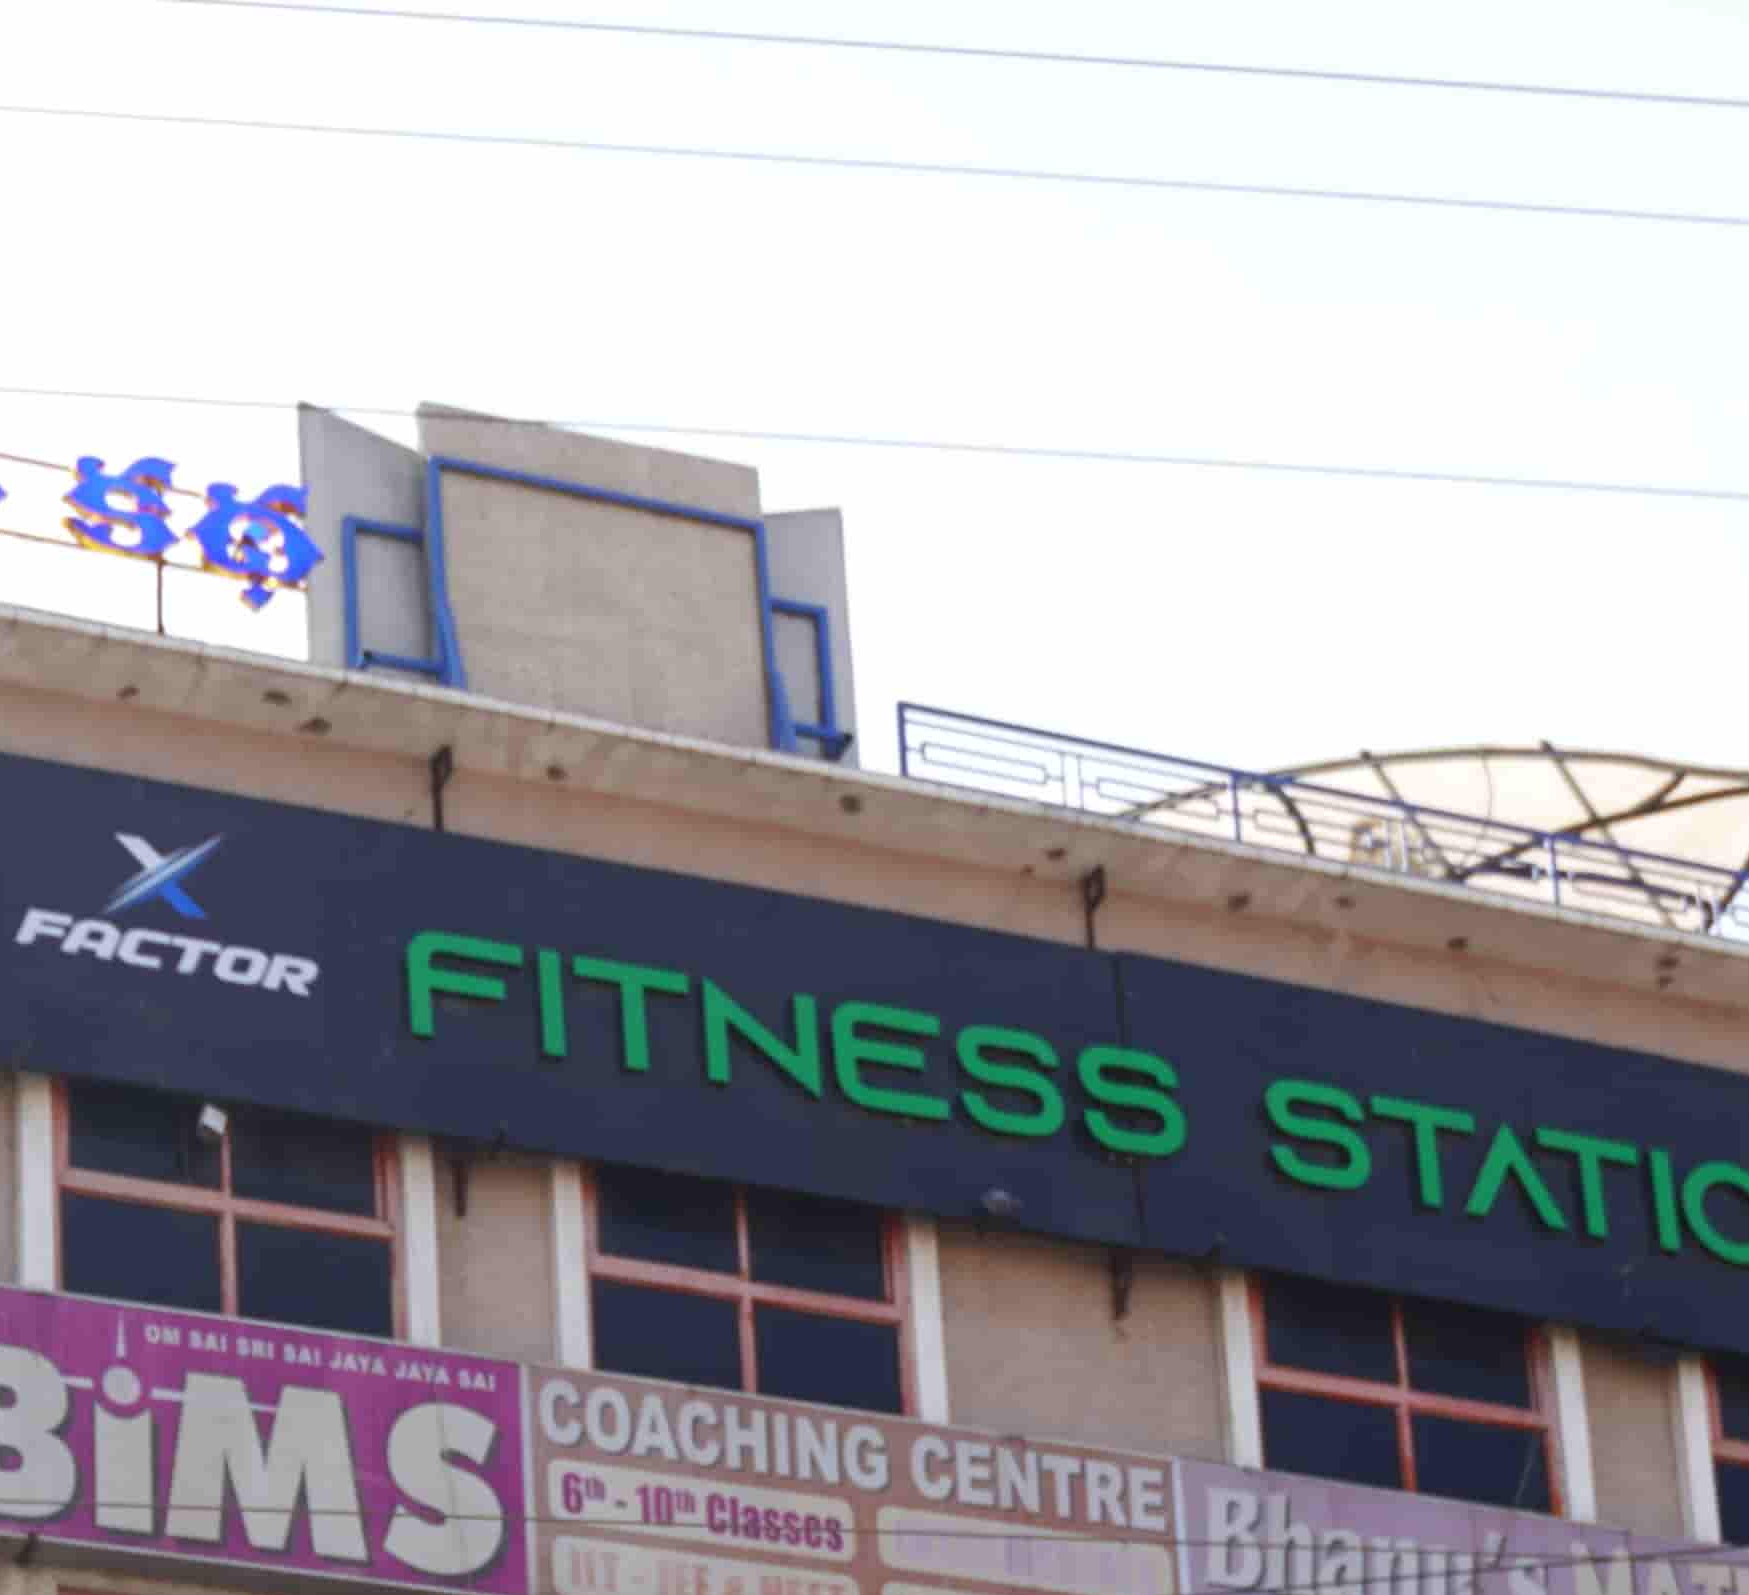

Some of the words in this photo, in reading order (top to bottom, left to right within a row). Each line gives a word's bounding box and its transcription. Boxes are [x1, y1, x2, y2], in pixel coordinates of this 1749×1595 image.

[61, 455, 324, 611] కథ
[15, 907, 319, 997] FACTOR
[405, 929, 1188, 1156] FITNESS
[144, 1322, 182, 1347] OM
[188, 1328, 228, 1356] SAI
[236, 1333, 275, 1362] SRI
[282, 1338, 323, 1367] SAI
[329, 1343, 387, 1378] JAYA
[394, 1352, 451, 1386] JAYA
[458, 1362, 497, 1394] SAI
[538, 1378, 890, 1492] COACHING
[910, 1433, 1166, 1533] CENTRE
[706, 1491, 845, 1554] Classes
